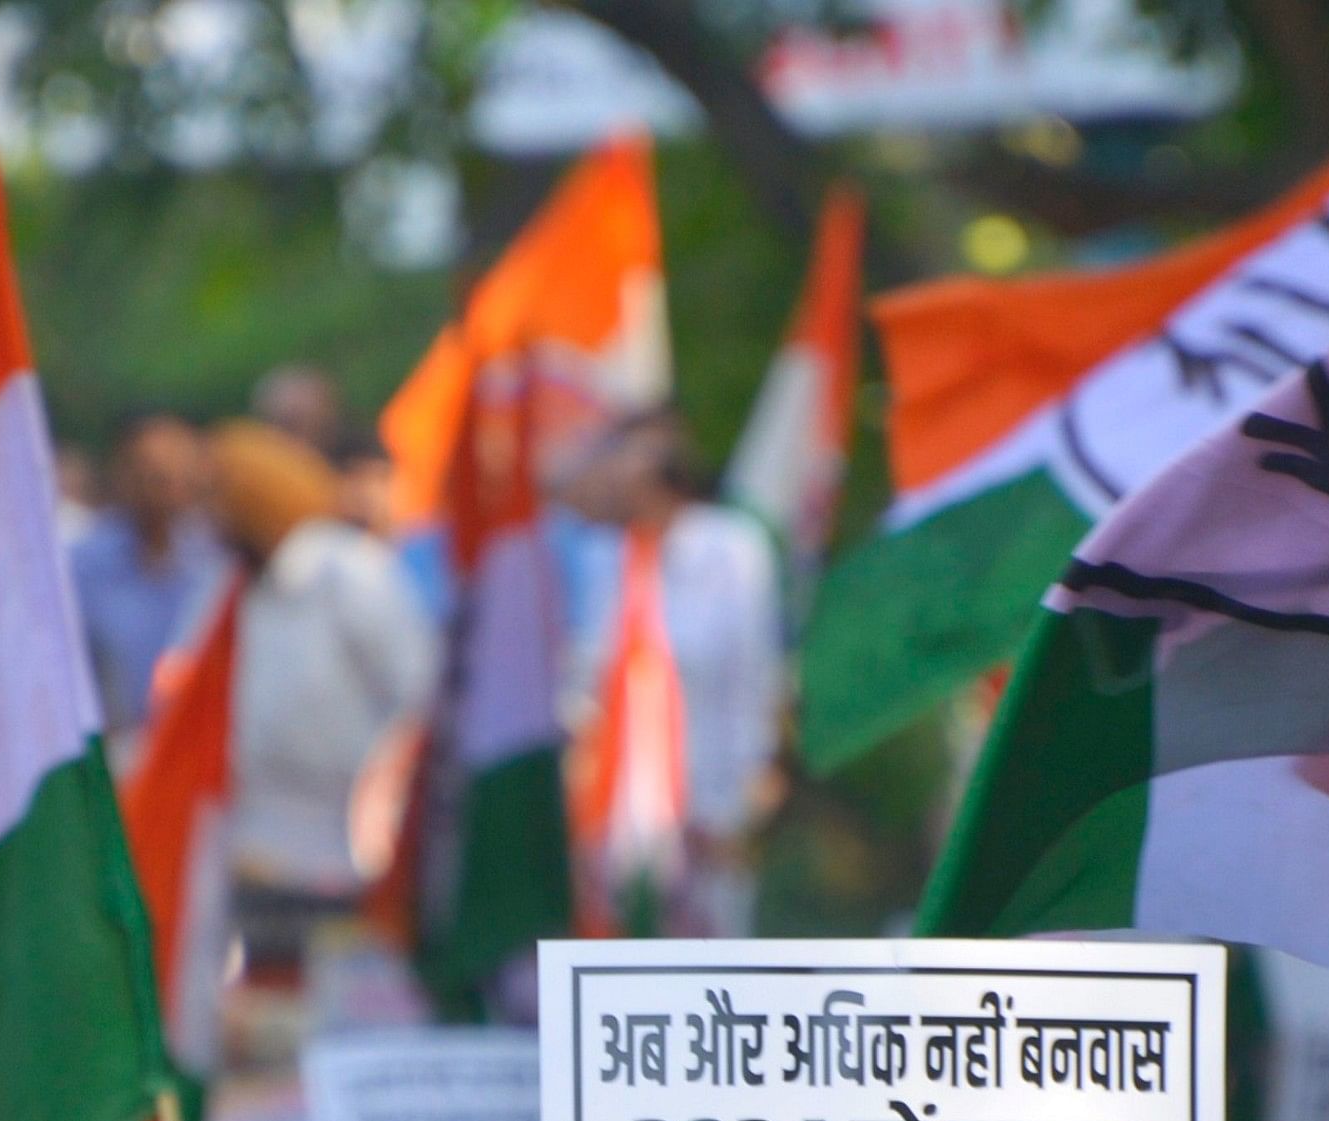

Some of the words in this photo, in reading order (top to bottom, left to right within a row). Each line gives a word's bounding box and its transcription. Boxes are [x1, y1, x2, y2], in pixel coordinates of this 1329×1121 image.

[599, 1013, 671, 1087] अब
[685, 987, 768, 1087] और
[782, 988, 911, 1087] अधिक
[920, 990, 1014, 1088] नहीं
[1015, 1017, 1171, 1093] बनवास
